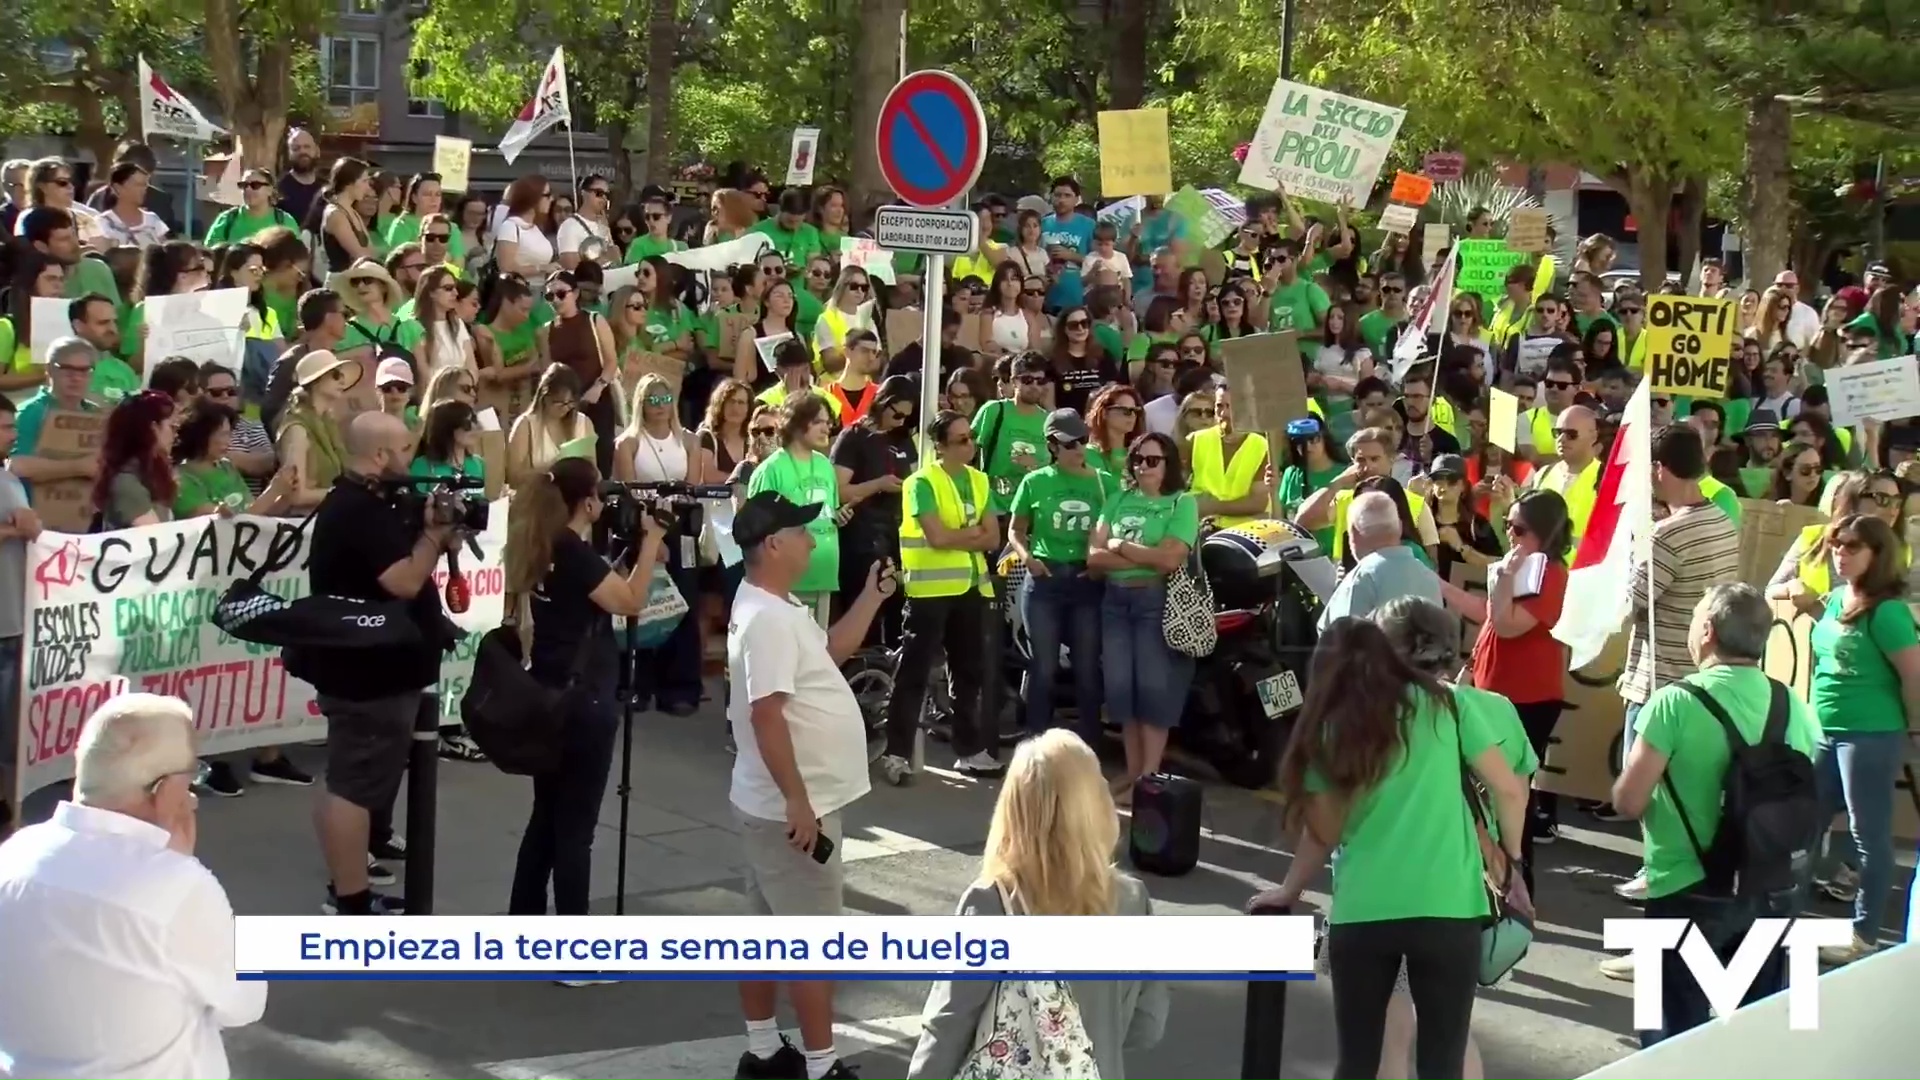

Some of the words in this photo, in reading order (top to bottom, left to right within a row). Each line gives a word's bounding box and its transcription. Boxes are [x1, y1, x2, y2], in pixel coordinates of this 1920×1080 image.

[1282, 90, 1309, 117] LA
[1316, 98, 1400, 138] SECCIÓ
[1311, 122, 1341, 141] DIU
[1274, 130, 1361, 180] PROU
[880, 215, 914, 228] EXCEPTO
[915, 219, 969, 231] CORPORACIÓN
[880, 232, 924, 244] LABORABLES
[925, 235, 942, 245] 07:00
[943, 237, 949, 246] A
[949, 237, 967, 247] 22:00
[1650, 301, 1732, 336] ORTÍ
[1671, 334, 1701, 355] GO
[1651, 354, 1729, 392] HOME
[92, 519, 310, 593] GUARD
[32, 601, 101, 648] ESCOLES
[357, 614, 386, 627] ace
[30, 641, 93, 690] UNIDES
[1265, 673, 1296, 696] 2703
[1271, 690, 1293, 710] MGP
